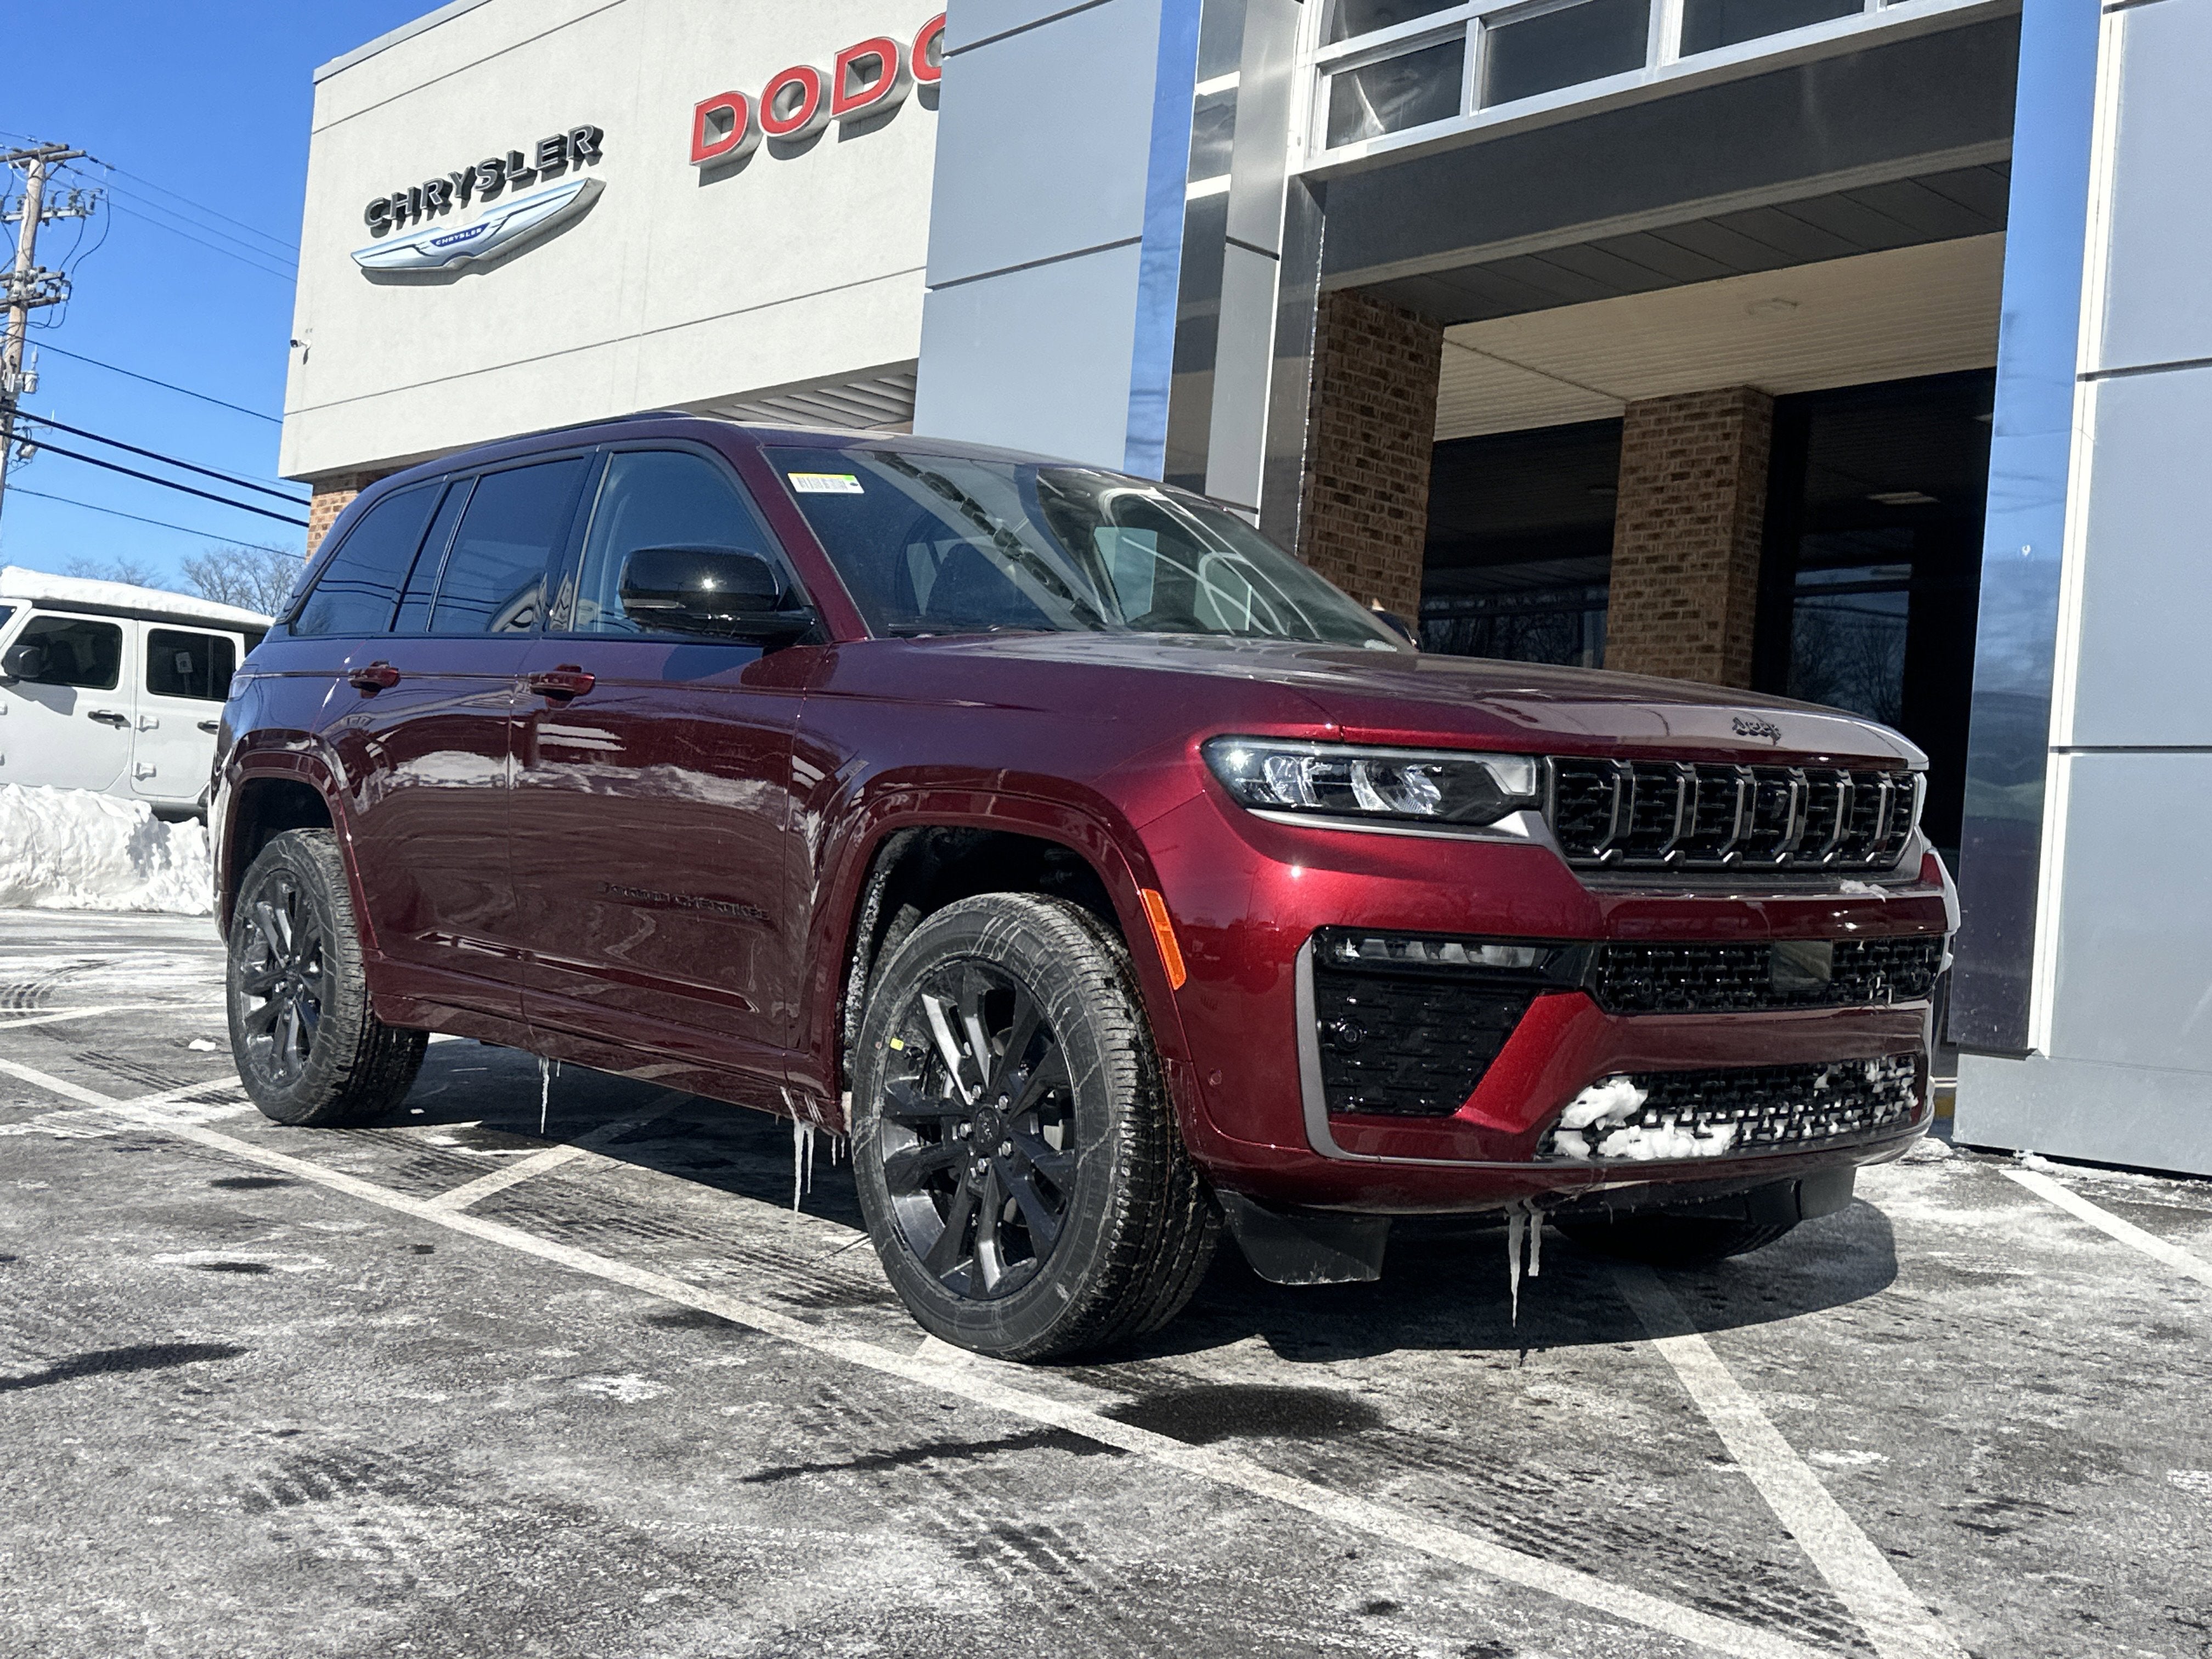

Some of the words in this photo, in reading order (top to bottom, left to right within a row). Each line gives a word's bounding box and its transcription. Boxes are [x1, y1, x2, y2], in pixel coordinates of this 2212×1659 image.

[363, 123, 600, 229] CHRYSLER
[436, 227, 483, 246] CHRYSLER
[1731, 716, 1781, 741] Jeep
